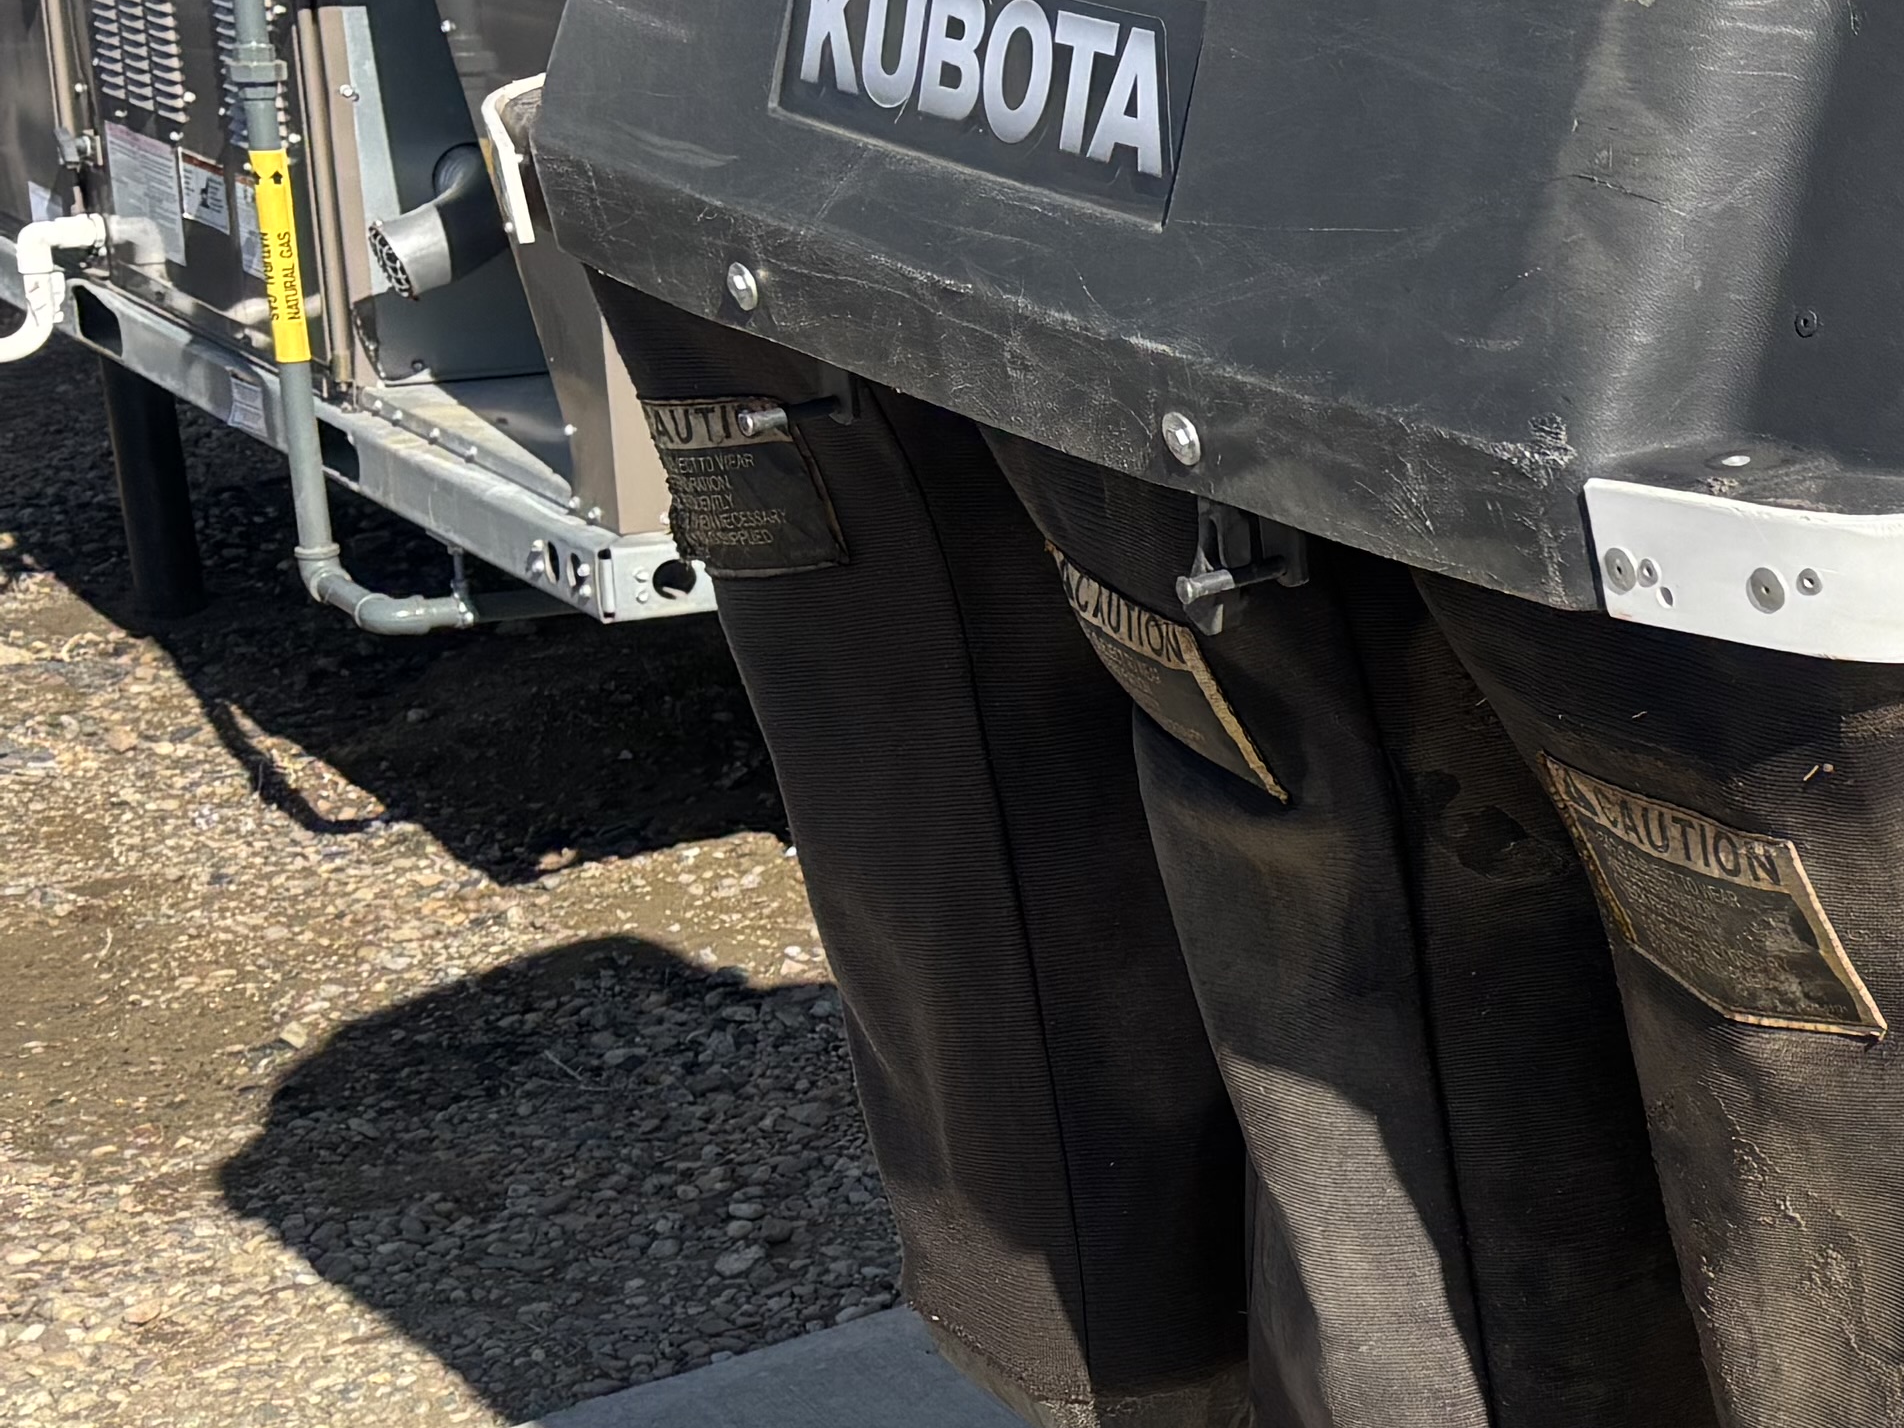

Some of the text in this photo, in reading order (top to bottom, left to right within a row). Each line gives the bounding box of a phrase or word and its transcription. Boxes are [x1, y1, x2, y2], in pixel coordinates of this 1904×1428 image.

[277, 231, 301, 320] NATURAL GAS
[1074, 576, 1187, 665] CAUTION
[1594, 784, 1781, 886] CAUTION
